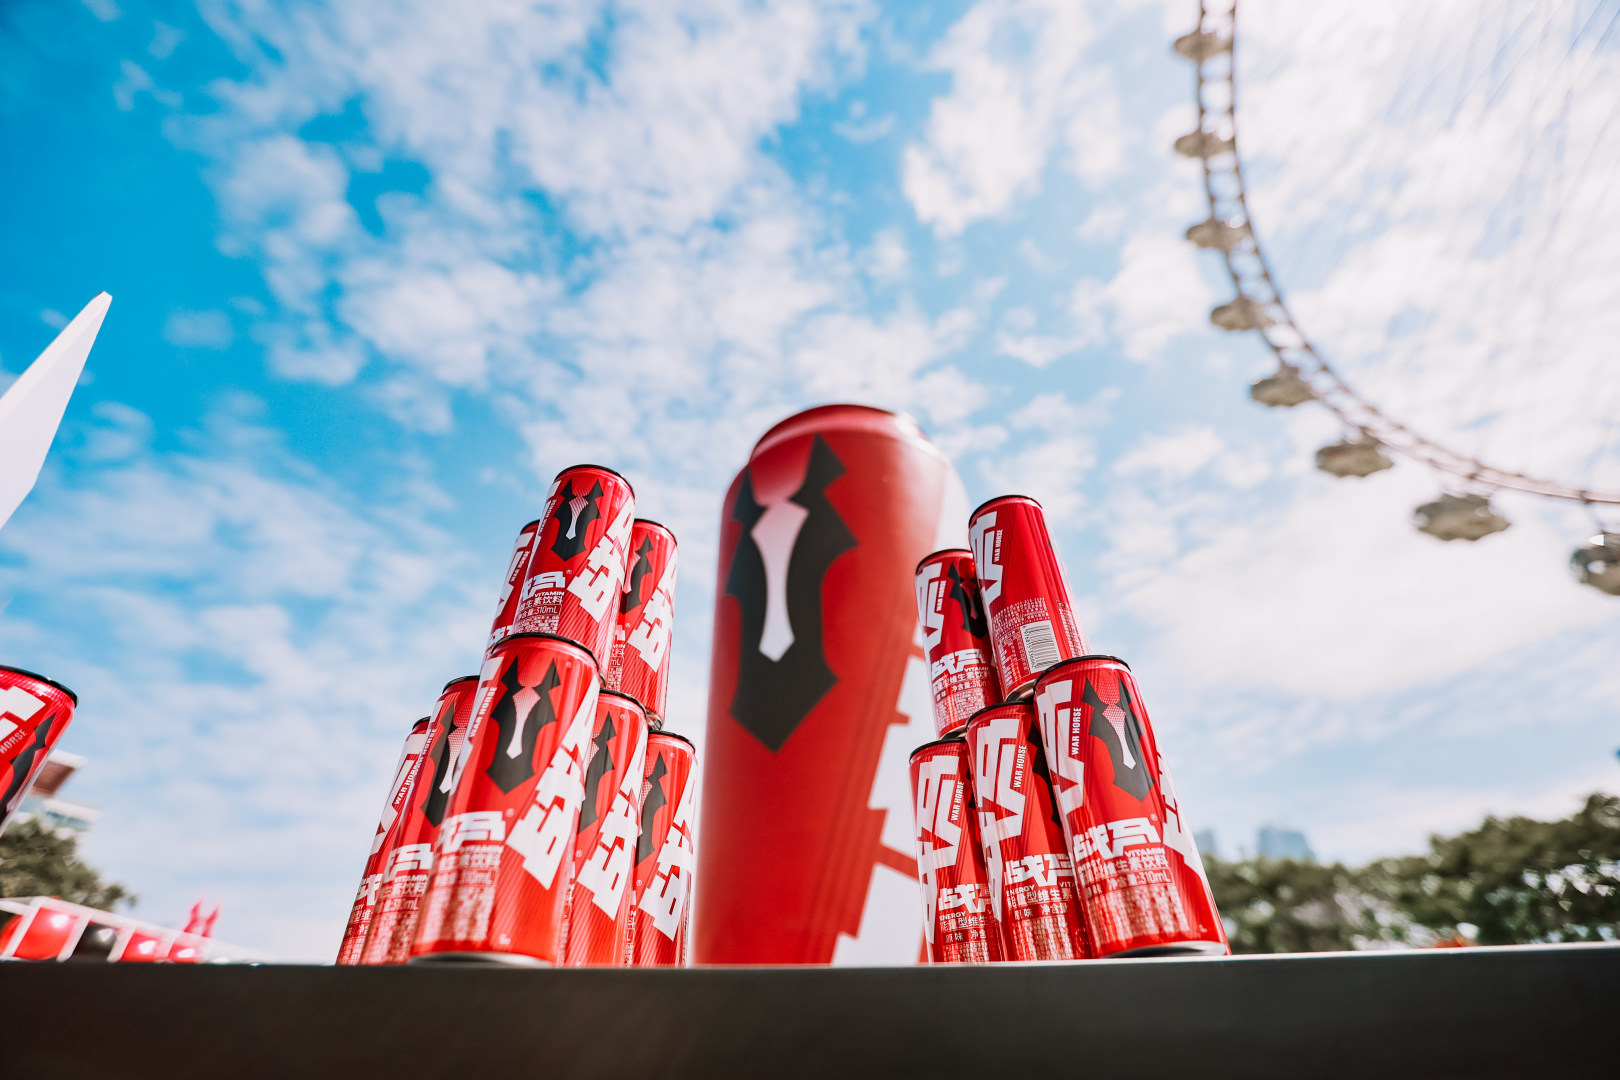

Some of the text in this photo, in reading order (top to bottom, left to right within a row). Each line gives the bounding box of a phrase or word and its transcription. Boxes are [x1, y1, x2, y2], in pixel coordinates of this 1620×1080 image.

[995, 529, 1003, 550] HORSE
[938, 580, 946, 598] HORSE
[469, 687, 498, 738] WAR HORSE
[1071, 707, 1082, 755] WAR HORSE
[1013, 744, 1027, 788] WAR HORSE
[394, 785, 408, 806] WAR
[950, 780, 965, 822] WAR HORSE
[1006, 885, 1035, 897] ENERGY
[939, 911, 966, 921] ENERGY
